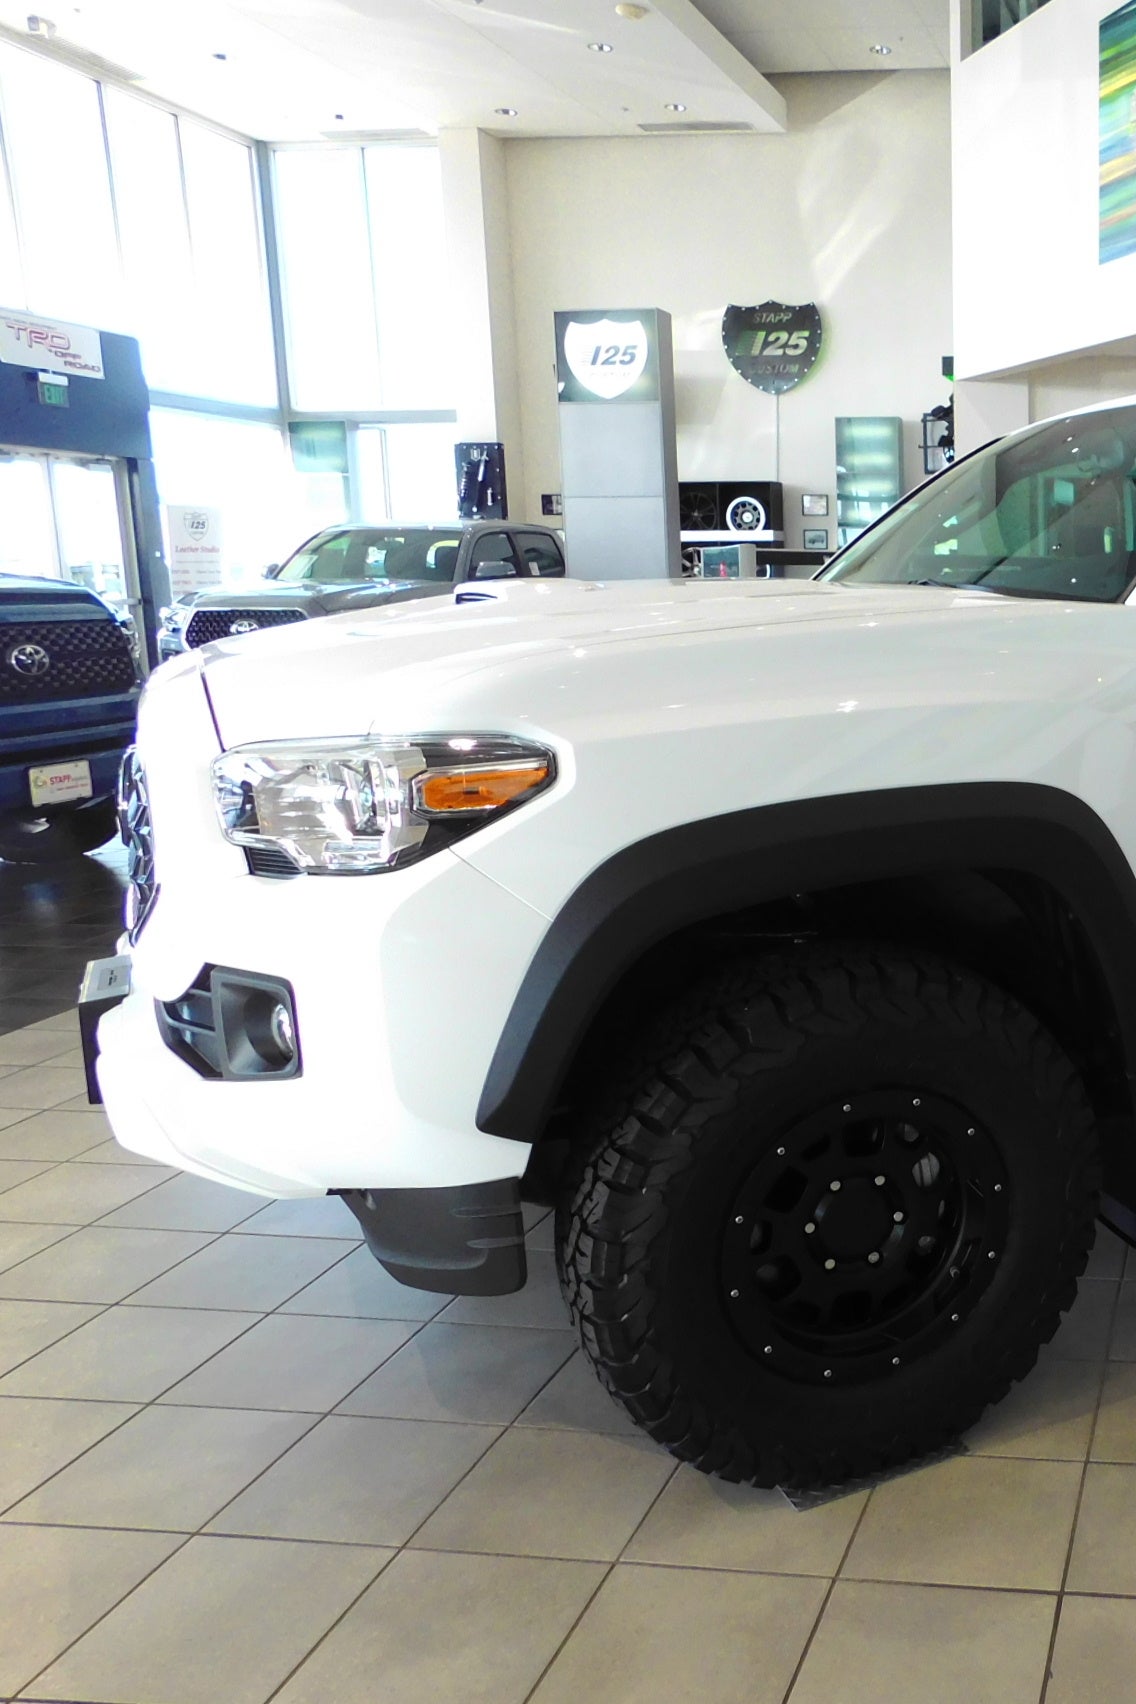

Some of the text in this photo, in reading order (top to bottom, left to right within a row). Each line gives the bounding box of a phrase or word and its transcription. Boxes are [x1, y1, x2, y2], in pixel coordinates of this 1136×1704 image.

[752, 312, 792, 324] STAPP
[6, 321, 71, 350] TRD
[751, 330, 810, 356] 125
[590, 345, 638, 366] 125
[64, 360, 101, 373] ROAD
[191, 521, 206, 529] 125
